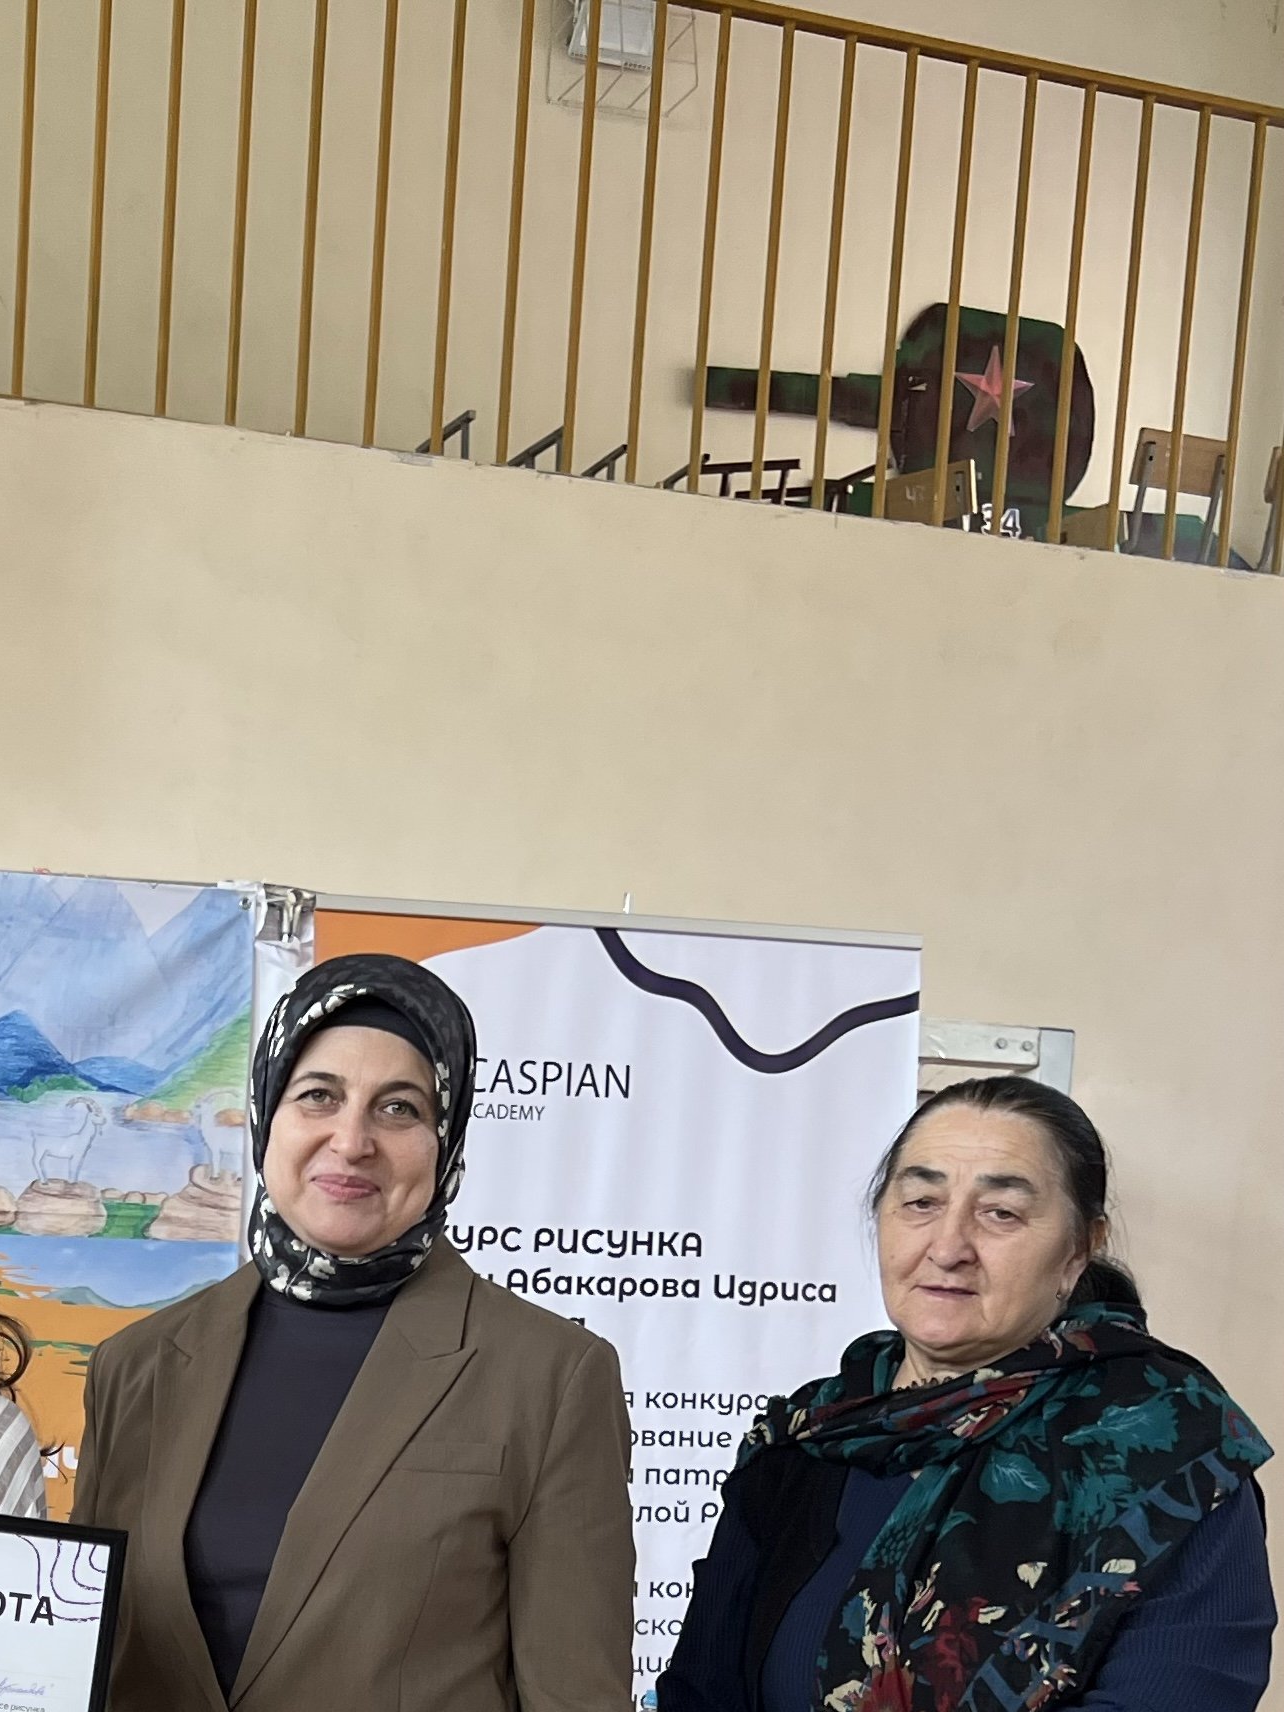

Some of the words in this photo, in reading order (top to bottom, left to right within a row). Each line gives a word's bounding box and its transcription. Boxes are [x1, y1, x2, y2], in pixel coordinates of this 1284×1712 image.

[469, 1102, 545, 1121] CADEMY
[533, 1227, 703, 1258] РИСУНКА
[506, 1267, 701, 1302] Абакарова
[714, 1274, 837, 1306] Идриса
